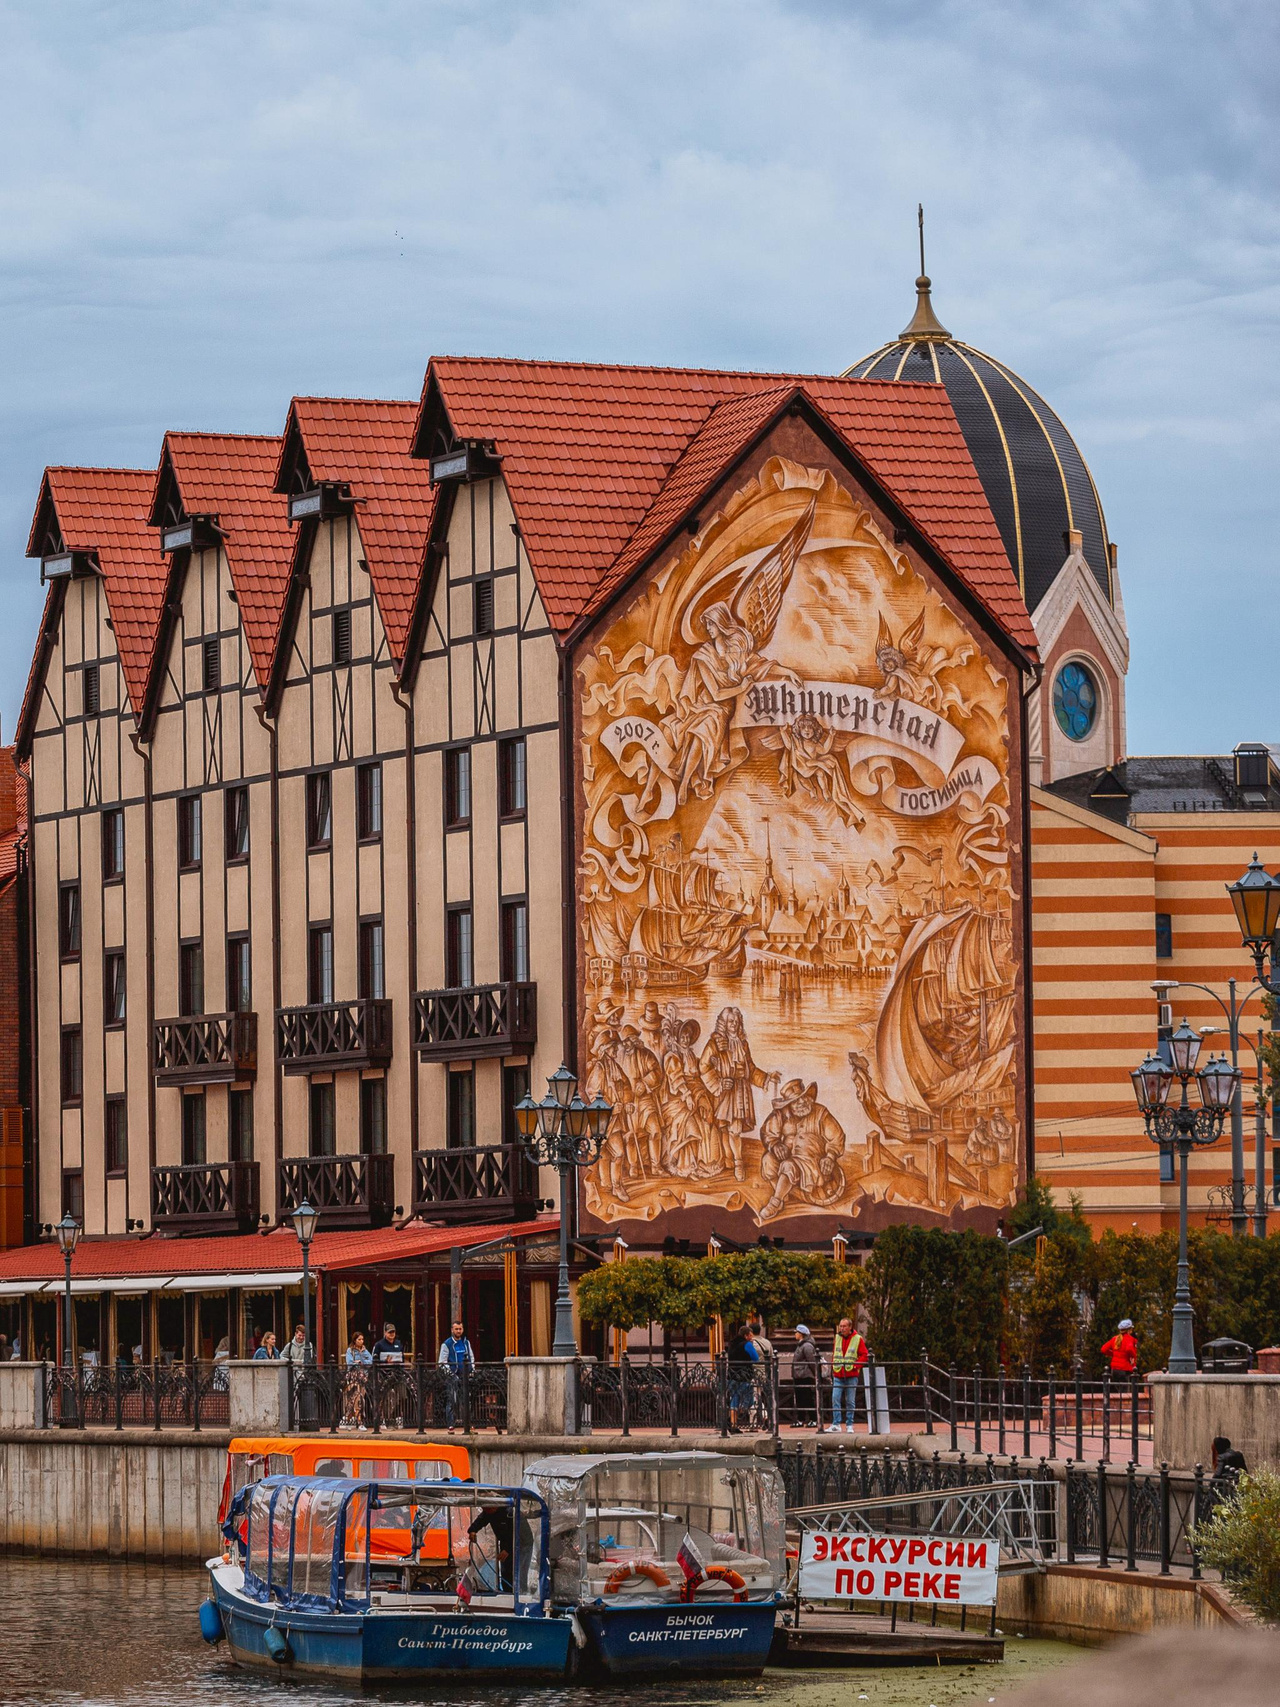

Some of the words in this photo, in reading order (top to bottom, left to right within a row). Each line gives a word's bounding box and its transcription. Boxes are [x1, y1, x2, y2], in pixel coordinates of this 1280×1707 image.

[744, 683, 942, 749] Шкиперская
[614, 722, 655, 743] 2007
[900, 767, 983, 810] ГОСТИНИЦА
[812, 1535, 987, 1569] ЭКСКУРСИИ
[835, 1568, 875, 1596] ПО
[883, 1570, 962, 1600] РЕКЕ
[431, 1624, 508, 1638] Грибоедов
[666, 1615, 714, 1626] БЫЧОК
[397, 1637, 533, 1653] Санкт-Петербург
[628, 1627, 748, 1642] САНКТ-ПЕТЕРБУРГ
